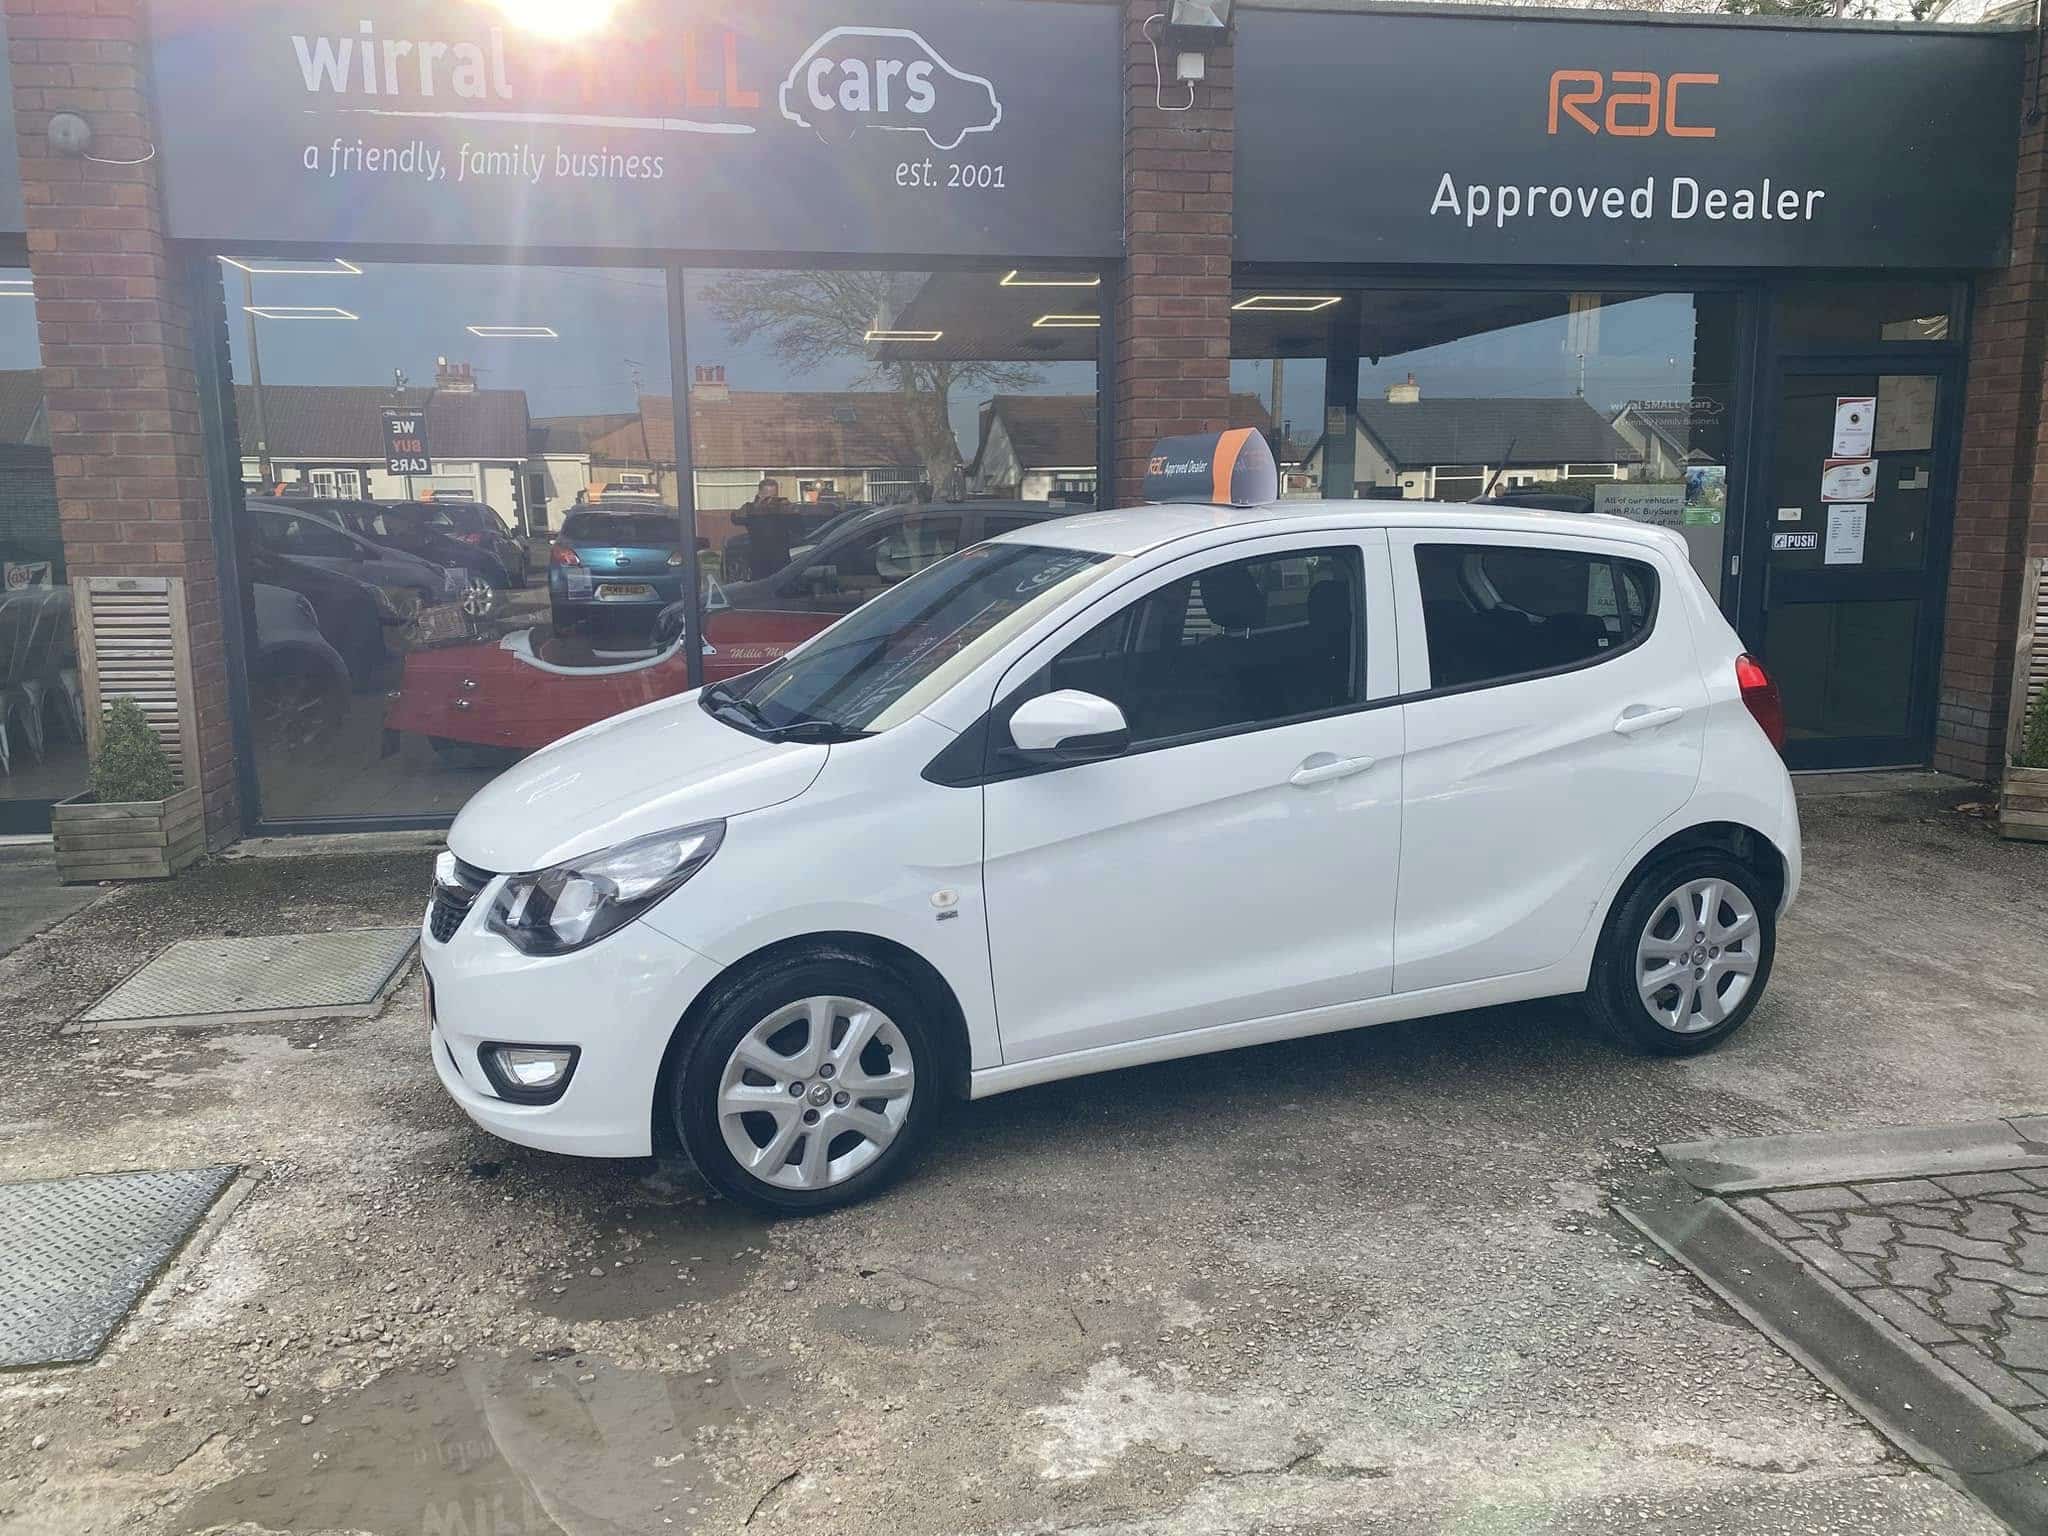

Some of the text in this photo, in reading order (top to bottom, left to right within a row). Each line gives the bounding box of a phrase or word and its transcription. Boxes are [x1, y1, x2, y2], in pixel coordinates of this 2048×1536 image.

[292, 20, 513, 100] wirral
[807, 56, 936, 114] cars
[303, 137, 664, 184] a friendly, family business
[896, 158, 1006, 189] est. 2001
[1431, 172, 1826, 228] Approved Dealer
[1787, 535, 1815, 547] PUSH
